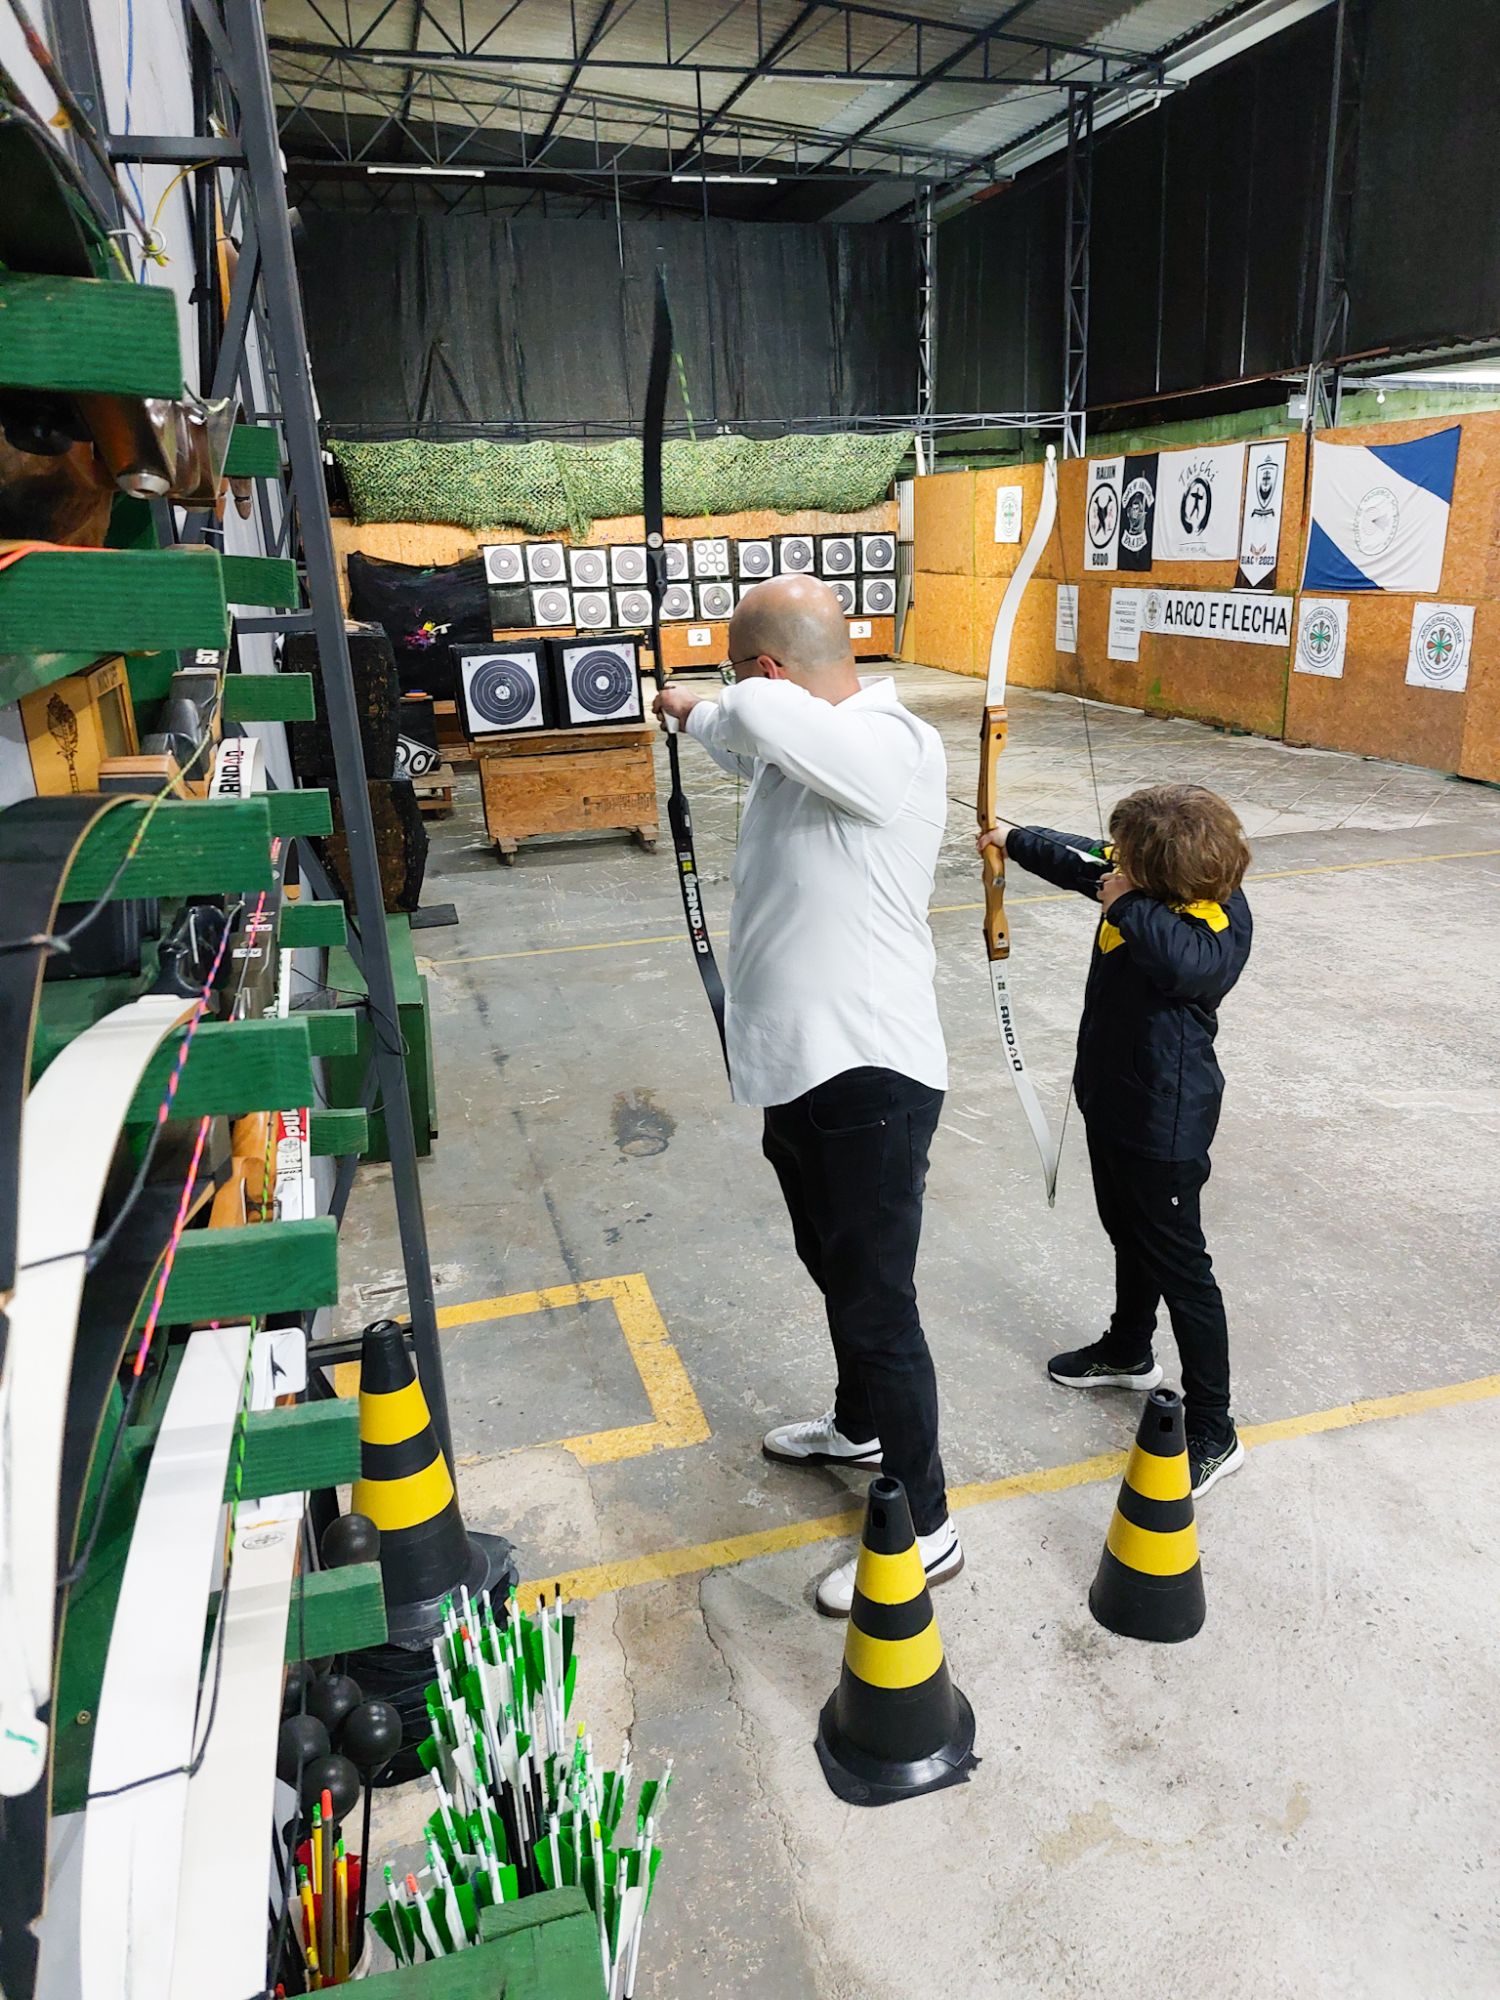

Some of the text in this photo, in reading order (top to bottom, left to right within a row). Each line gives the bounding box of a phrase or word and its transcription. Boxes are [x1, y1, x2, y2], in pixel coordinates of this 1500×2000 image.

[1164, 600, 1288, 636] ARCO E FLECHA
[857, 626, 865, 634] 3
[696, 633, 704, 641] 2
